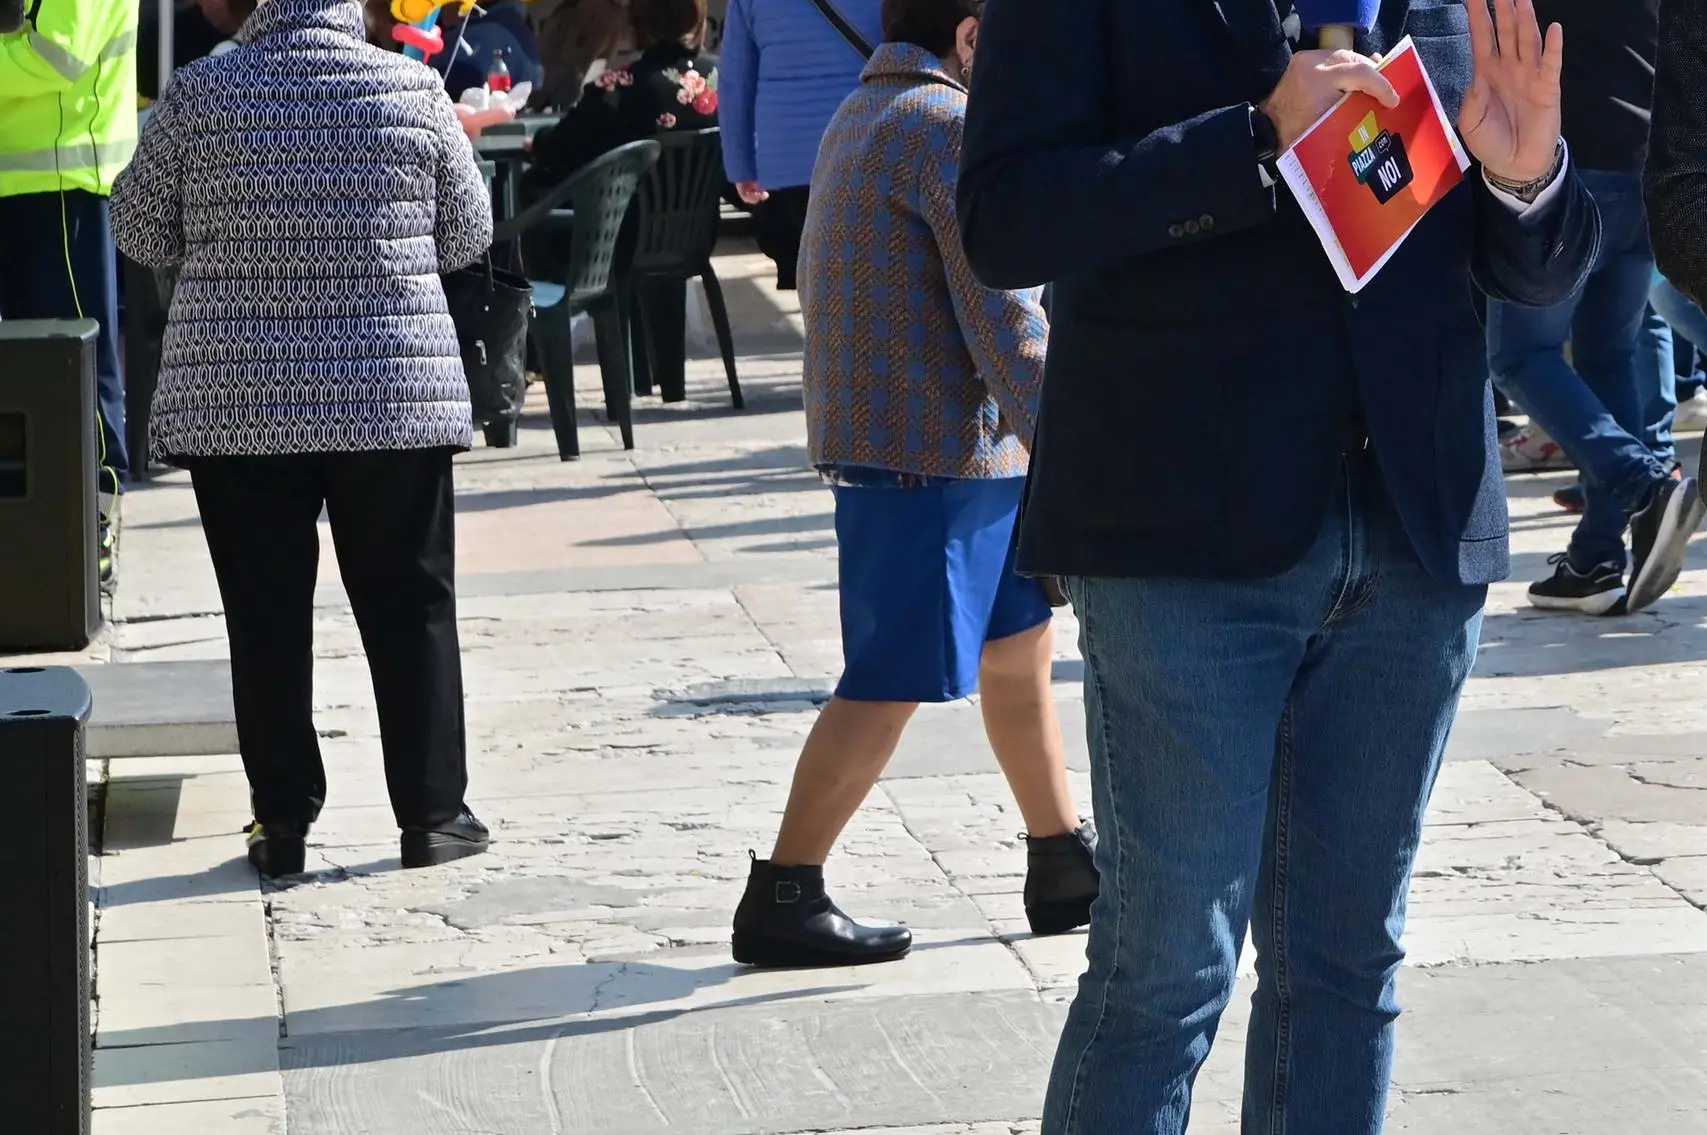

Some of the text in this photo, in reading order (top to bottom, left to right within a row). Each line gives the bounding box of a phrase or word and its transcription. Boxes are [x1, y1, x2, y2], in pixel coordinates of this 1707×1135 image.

[1358, 125, 1370, 143] IN
[1352, 146, 1376, 177] PIAZZA
[1377, 155, 1402, 192] NOI
